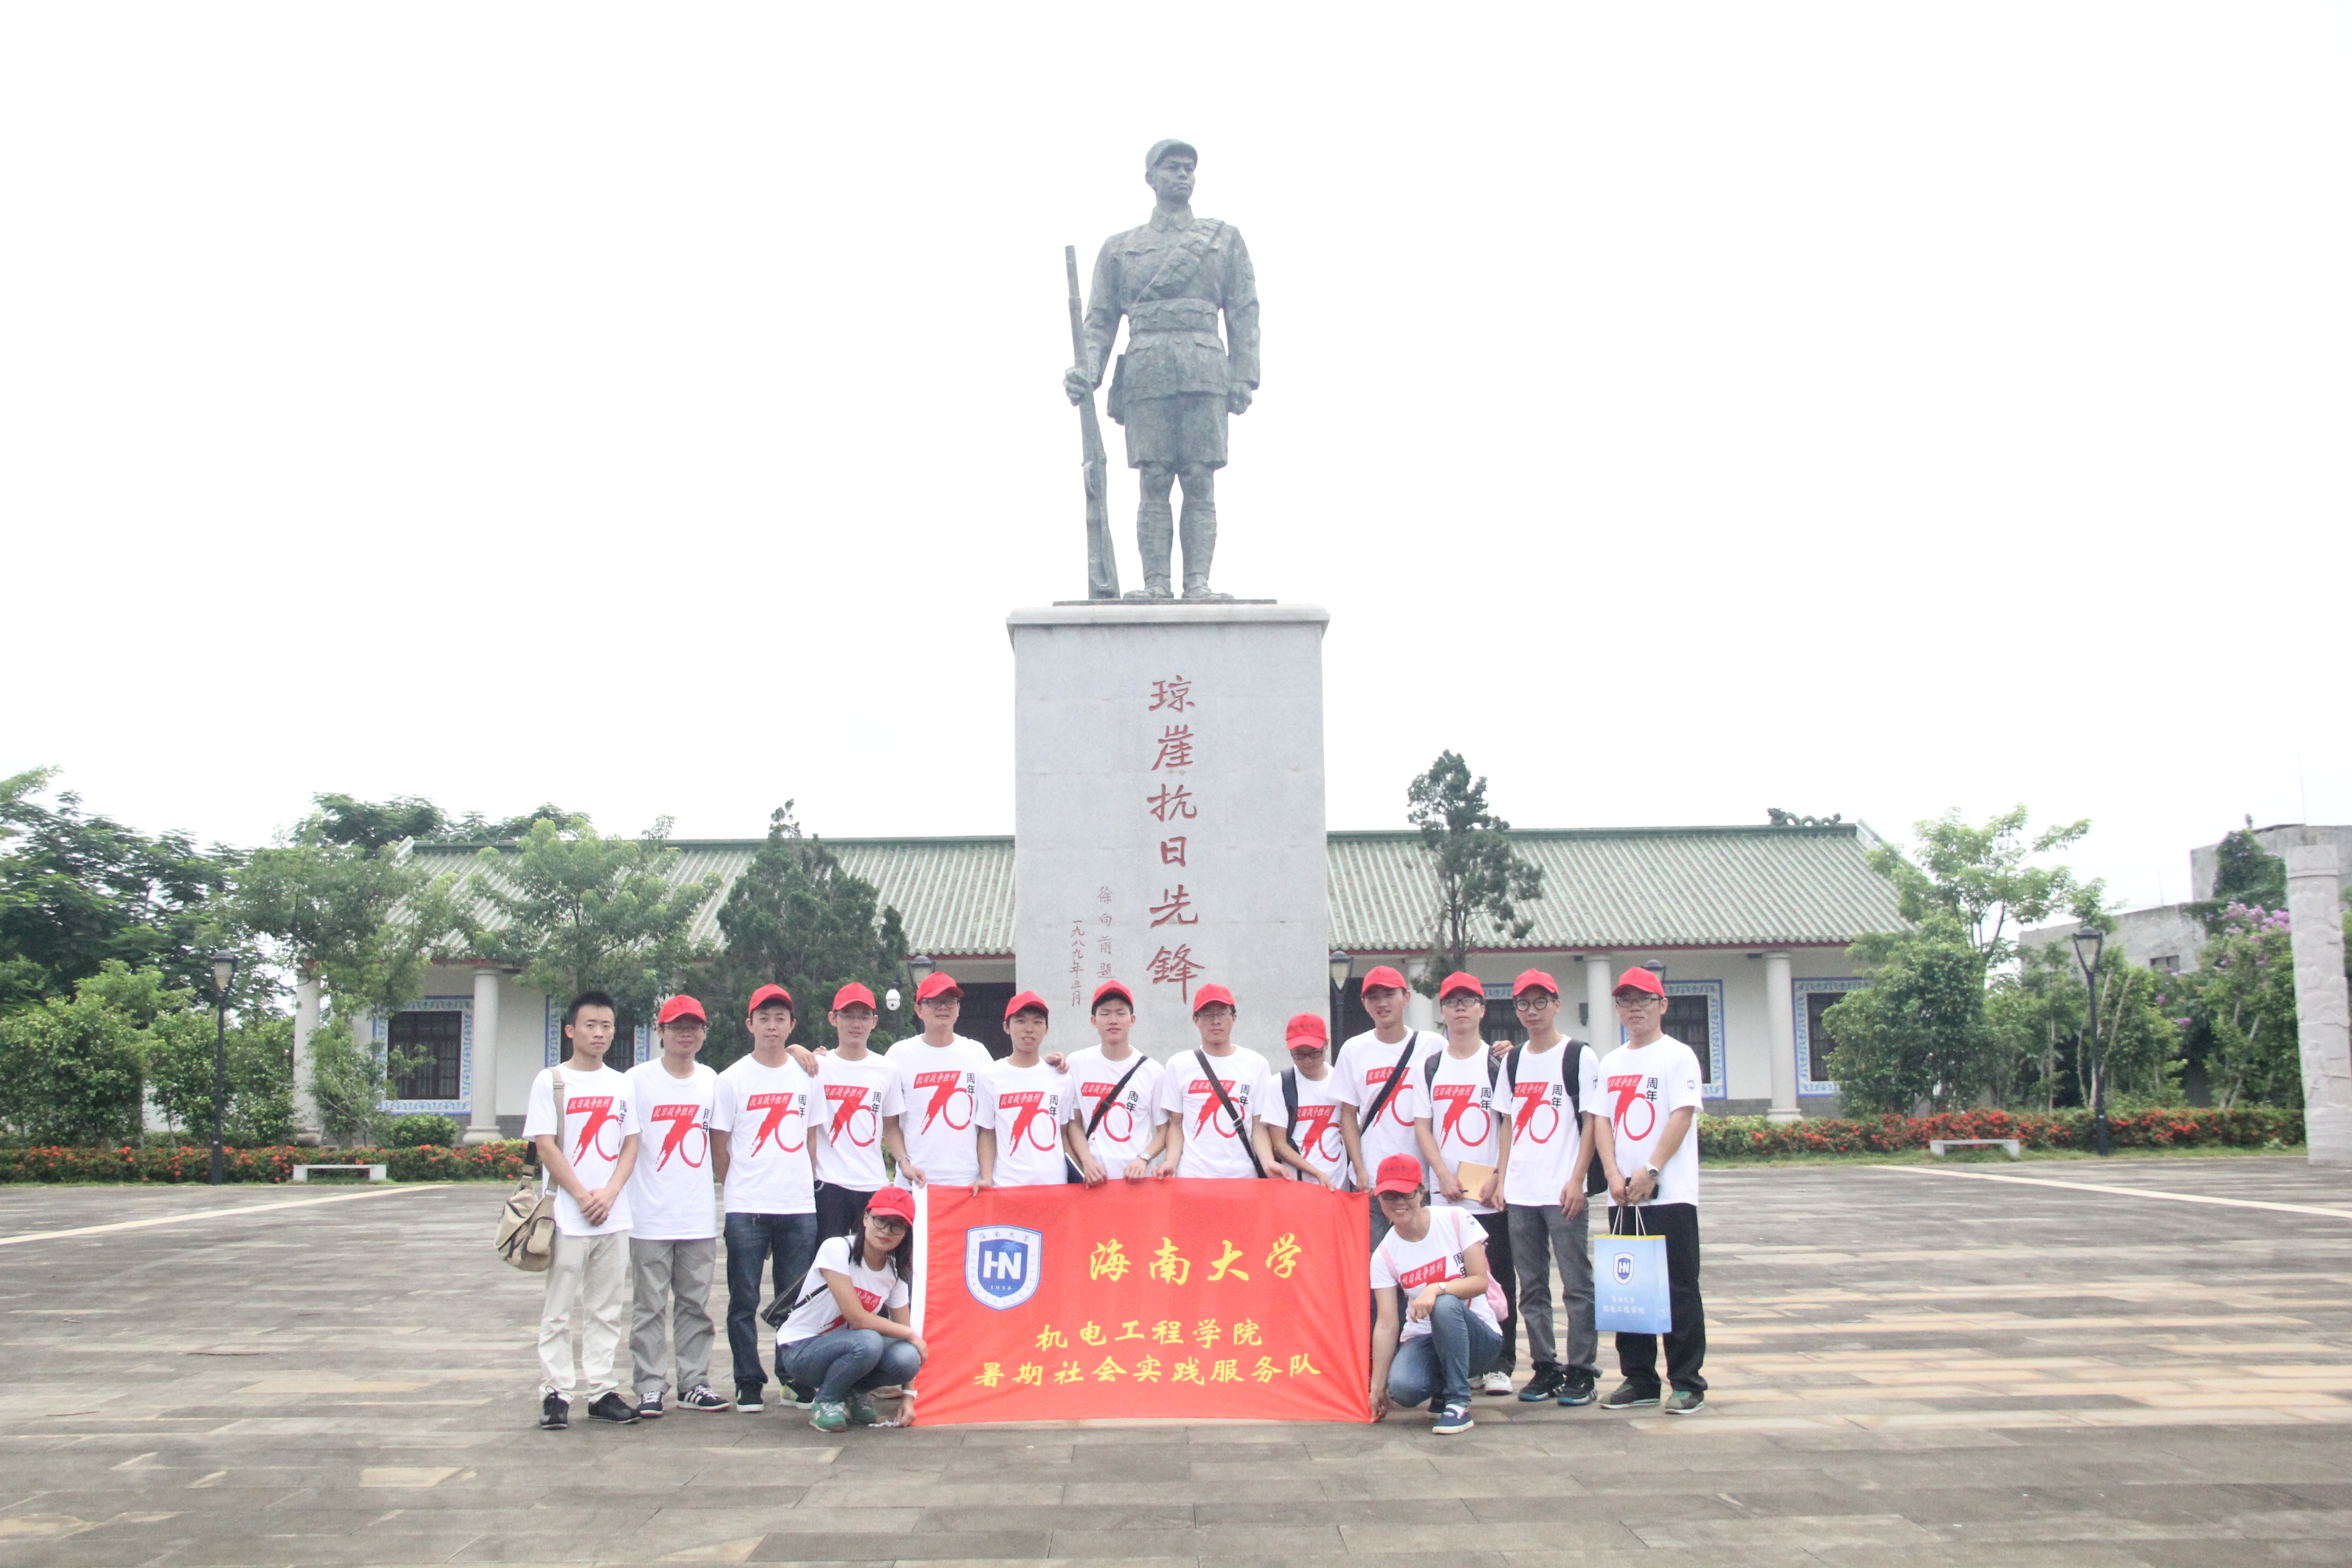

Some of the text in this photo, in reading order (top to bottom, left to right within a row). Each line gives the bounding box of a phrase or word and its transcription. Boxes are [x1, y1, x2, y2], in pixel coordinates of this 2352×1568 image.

[1069, 920, 1084, 1006] 一九八九年五月
[916, 1072, 958, 1084] 抗日战争胜利
[967, 1073, 975, 1095] 周年
[1646, 1078, 1658, 1102] 周年
[568, 1098, 610, 1110] 抗日战争胜利
[749, 1094, 788, 1106] 抗日战争胜利
[871, 1092, 881, 1114] 周年
[913, 1071, 973, 1135] 70
[1000, 1093, 1041, 1105] 抗日战争胜利
[1125, 1091, 1138, 1112] 周年
[1239, 1084, 1250, 1106] 周年
[1433, 1086, 1472, 1097] 抗日战争胜利
[1480, 1088, 1491, 1110] 周年
[1551, 1085, 1563, 1108] 周年
[653, 1106, 696, 1117] 抗日战争胜利
[824, 1085, 876, 1147] 70
[1049, 1095, 1058, 1117] 周年
[1188, 1080, 1245, 1140] 70
[1433, 1084, 1490, 1150] 70
[1513, 1082, 1559, 1146] 70
[1607, 1074, 1655, 1144] 70
[566, 1096, 622, 1167] 70
[746, 1093, 804, 1157] 70
[999, 1091, 1056, 1156] 70
[1296, 1105, 1342, 1162] 70
[651, 1104, 707, 1172] 70
[983, 1250, 1022, 1279] HN
[1090, 1233, 1302, 1286] 海南大学
[1401, 1260, 1443, 1284] 抗日战争胜利
[1618, 1262, 1630, 1274] HN
[1035, 1318, 1263, 1351] 机电工程学院
[974, 1354, 1322, 1388] 暑期社会实践服务队
